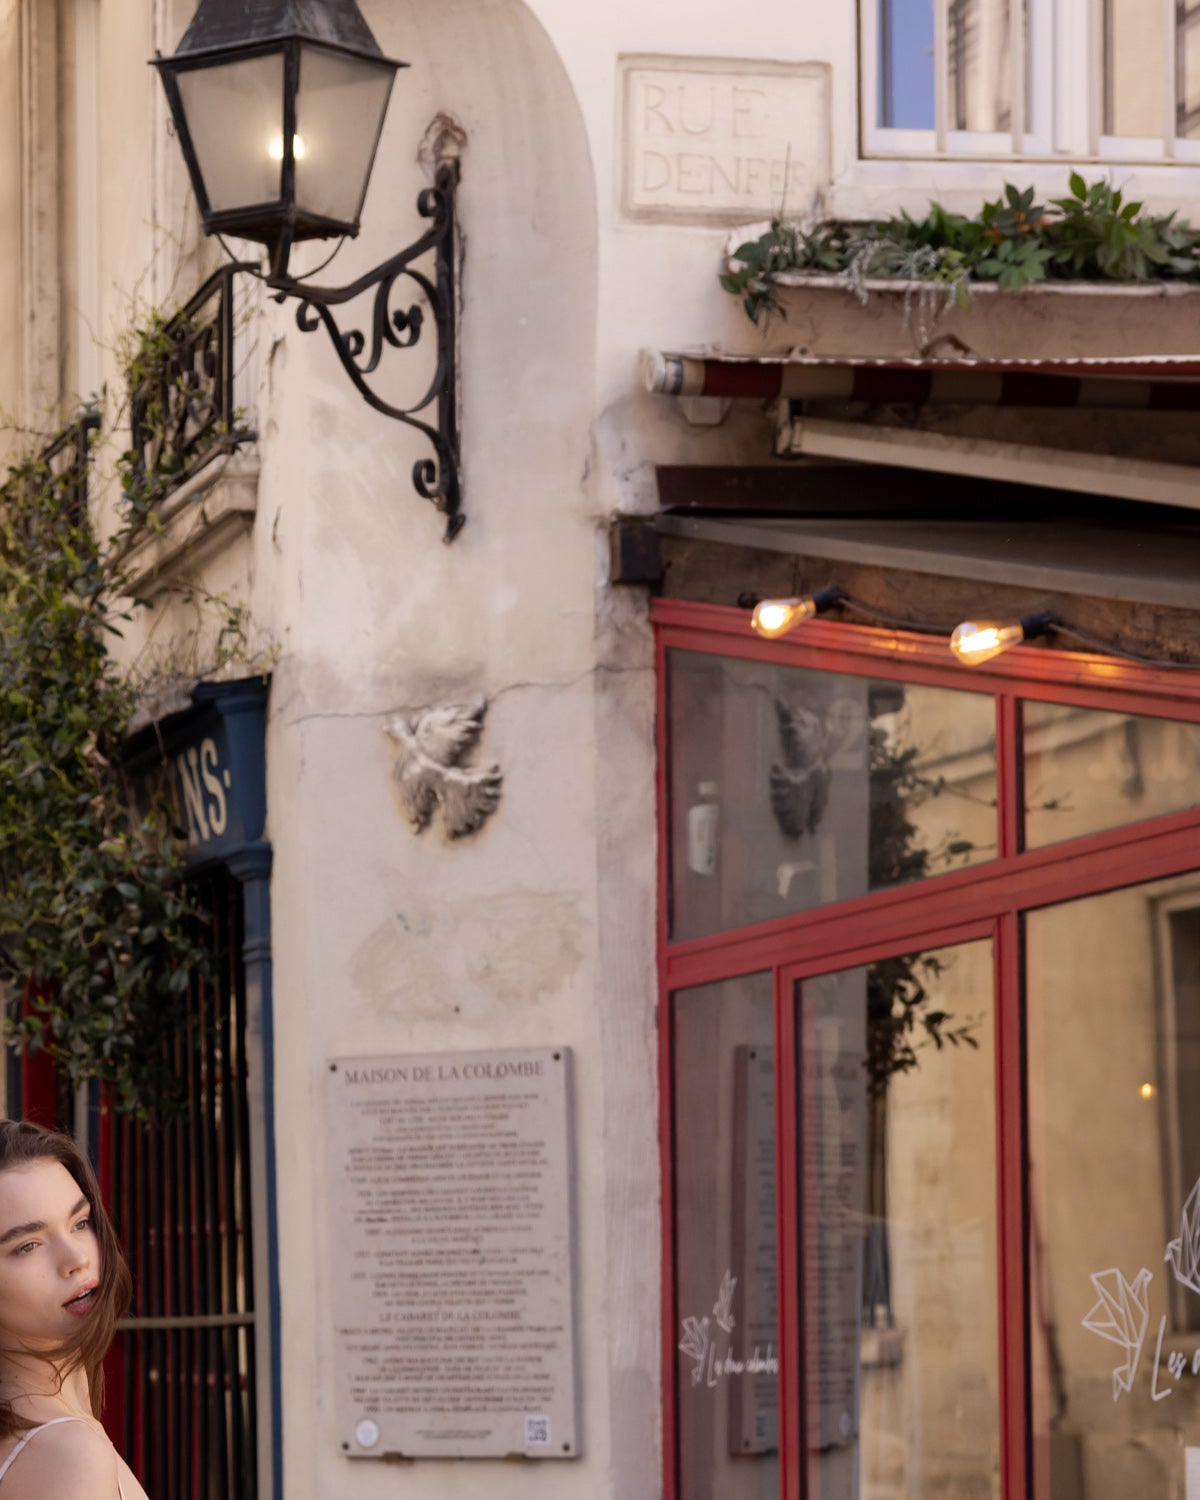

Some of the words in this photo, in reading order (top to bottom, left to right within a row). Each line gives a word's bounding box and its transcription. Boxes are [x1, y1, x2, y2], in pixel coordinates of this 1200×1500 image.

[642, 83, 765, 138] RUE
[345, 1066, 408, 1086] MAISON
[412, 1065, 433, 1082] DE
[438, 1064, 459, 1081] LA
[462, 1060, 544, 1079] COLOMBE
[1151, 1314, 1188, 1402] Les
